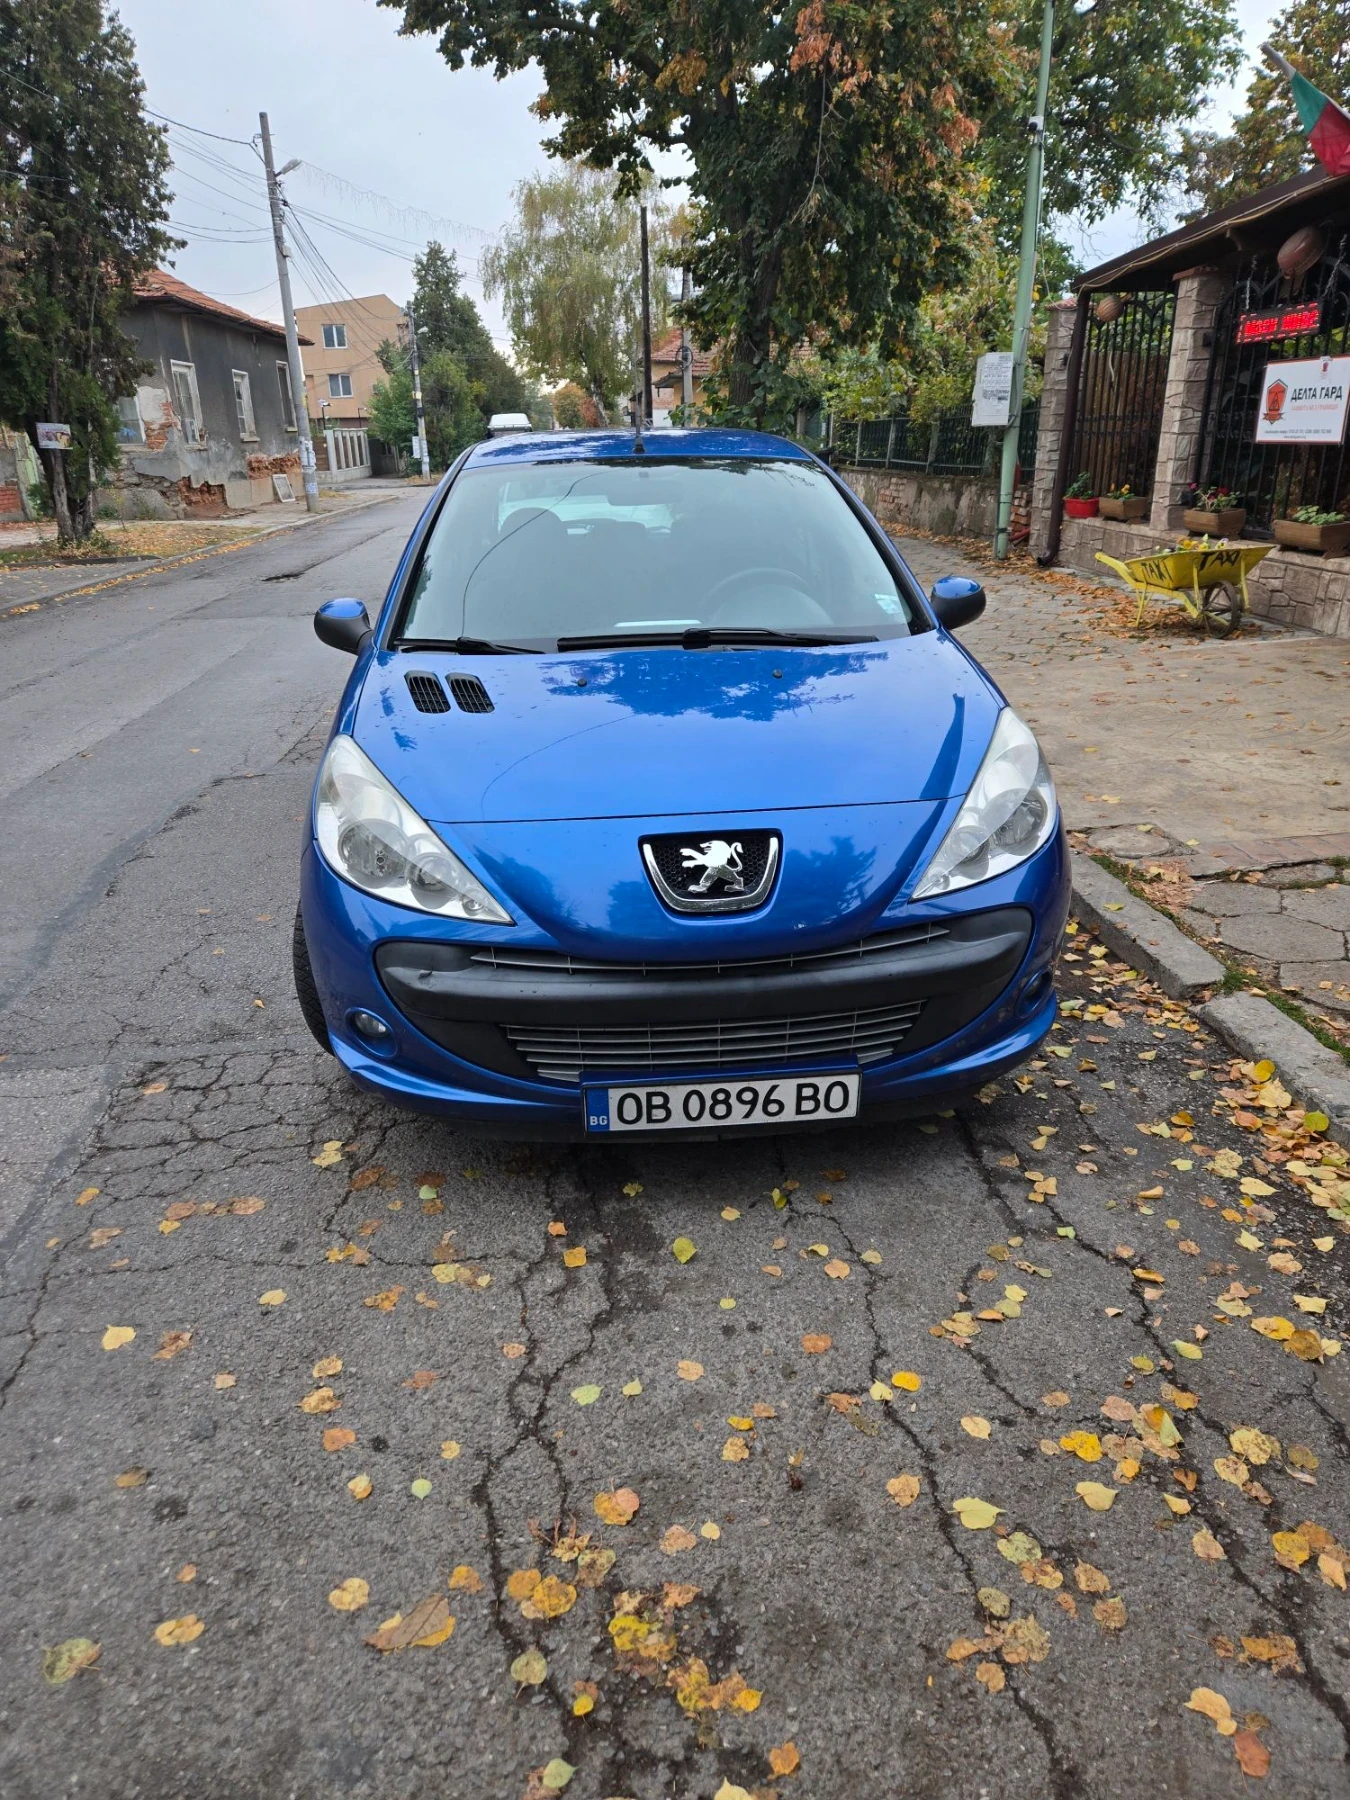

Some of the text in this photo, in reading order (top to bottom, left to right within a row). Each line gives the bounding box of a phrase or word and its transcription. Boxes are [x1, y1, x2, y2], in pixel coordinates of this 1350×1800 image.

[1291, 386, 1343, 402] ДЕЛТА ГАРД
[1141, 559, 1174, 583] TAXI
[617, 1080, 850, 1125] OB 0896 BO
[589, 1115, 608, 1126] BG
